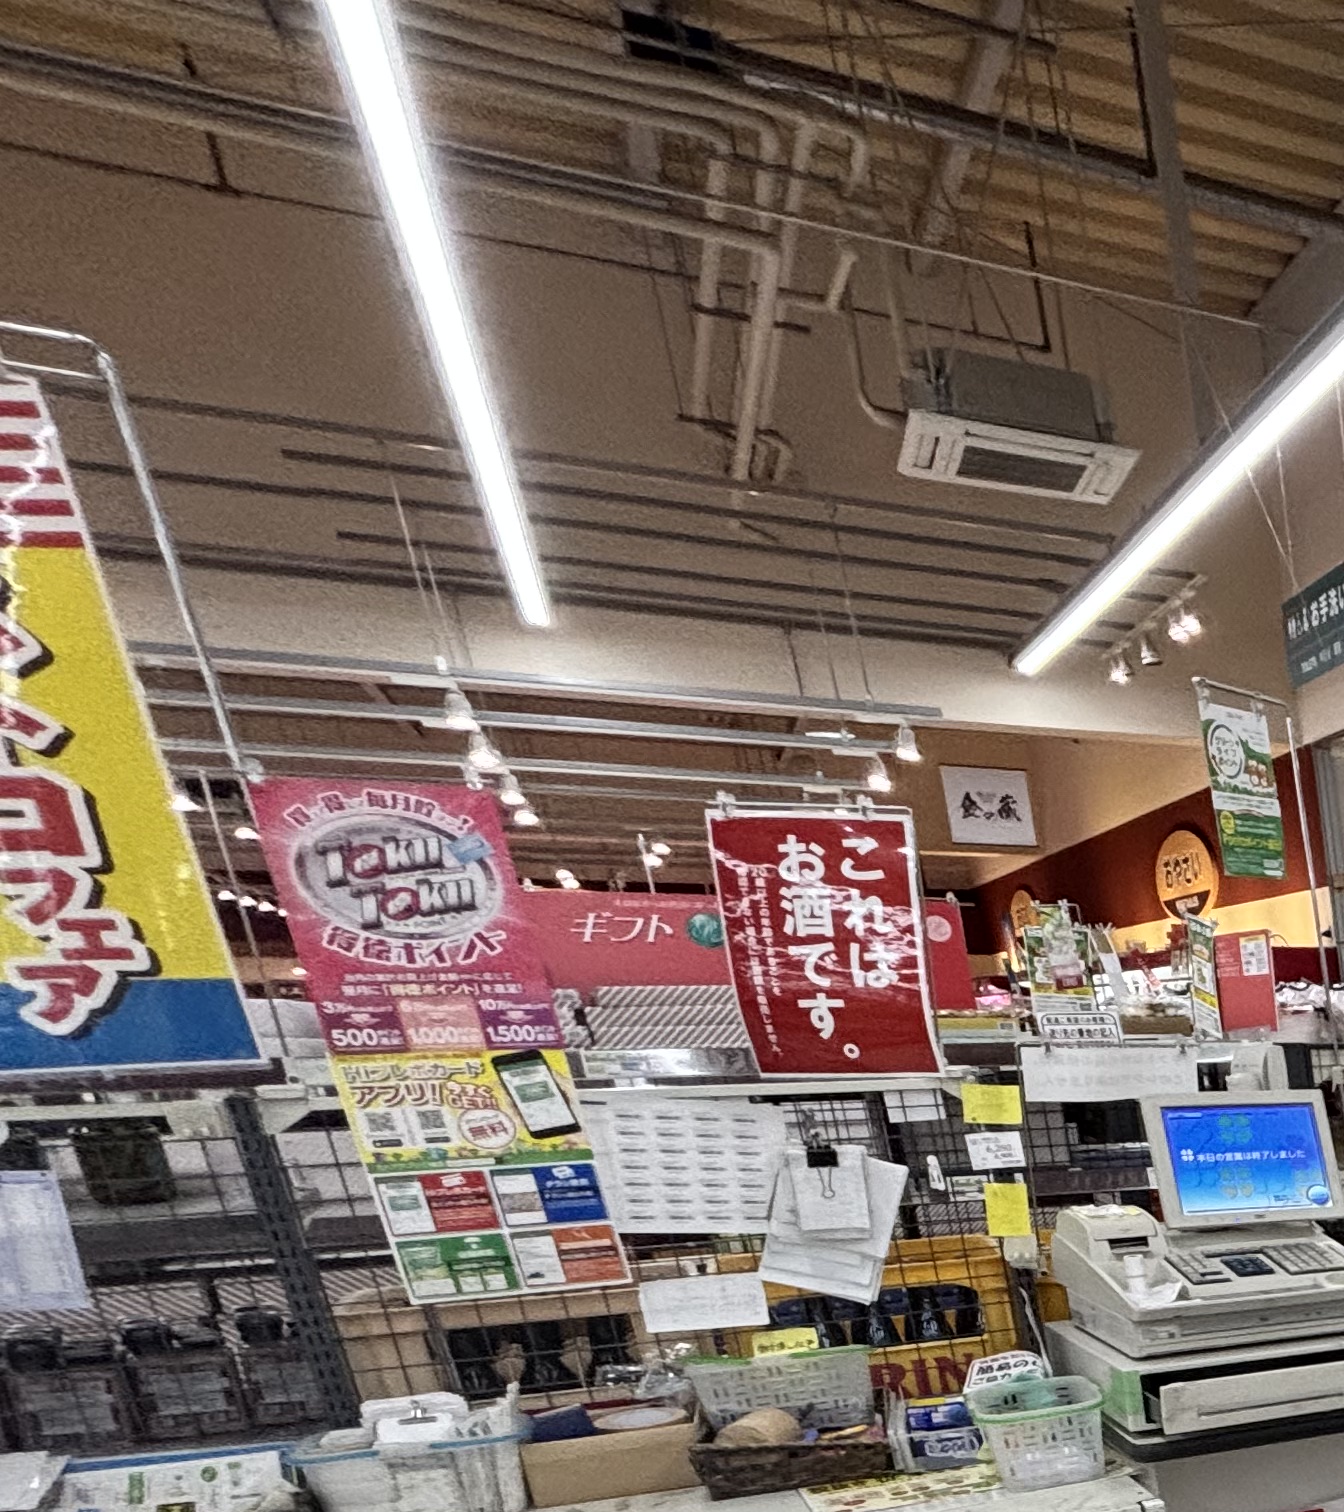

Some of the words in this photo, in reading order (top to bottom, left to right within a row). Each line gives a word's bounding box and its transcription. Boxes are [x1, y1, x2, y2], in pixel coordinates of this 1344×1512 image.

[569, 911, 675, 943] ギフト
[777, 833, 861, 1061] お酒です。
[840, 835, 902, 991] これは
[1195, 1149, 1307, 1163] 本日の営業は終了しました
